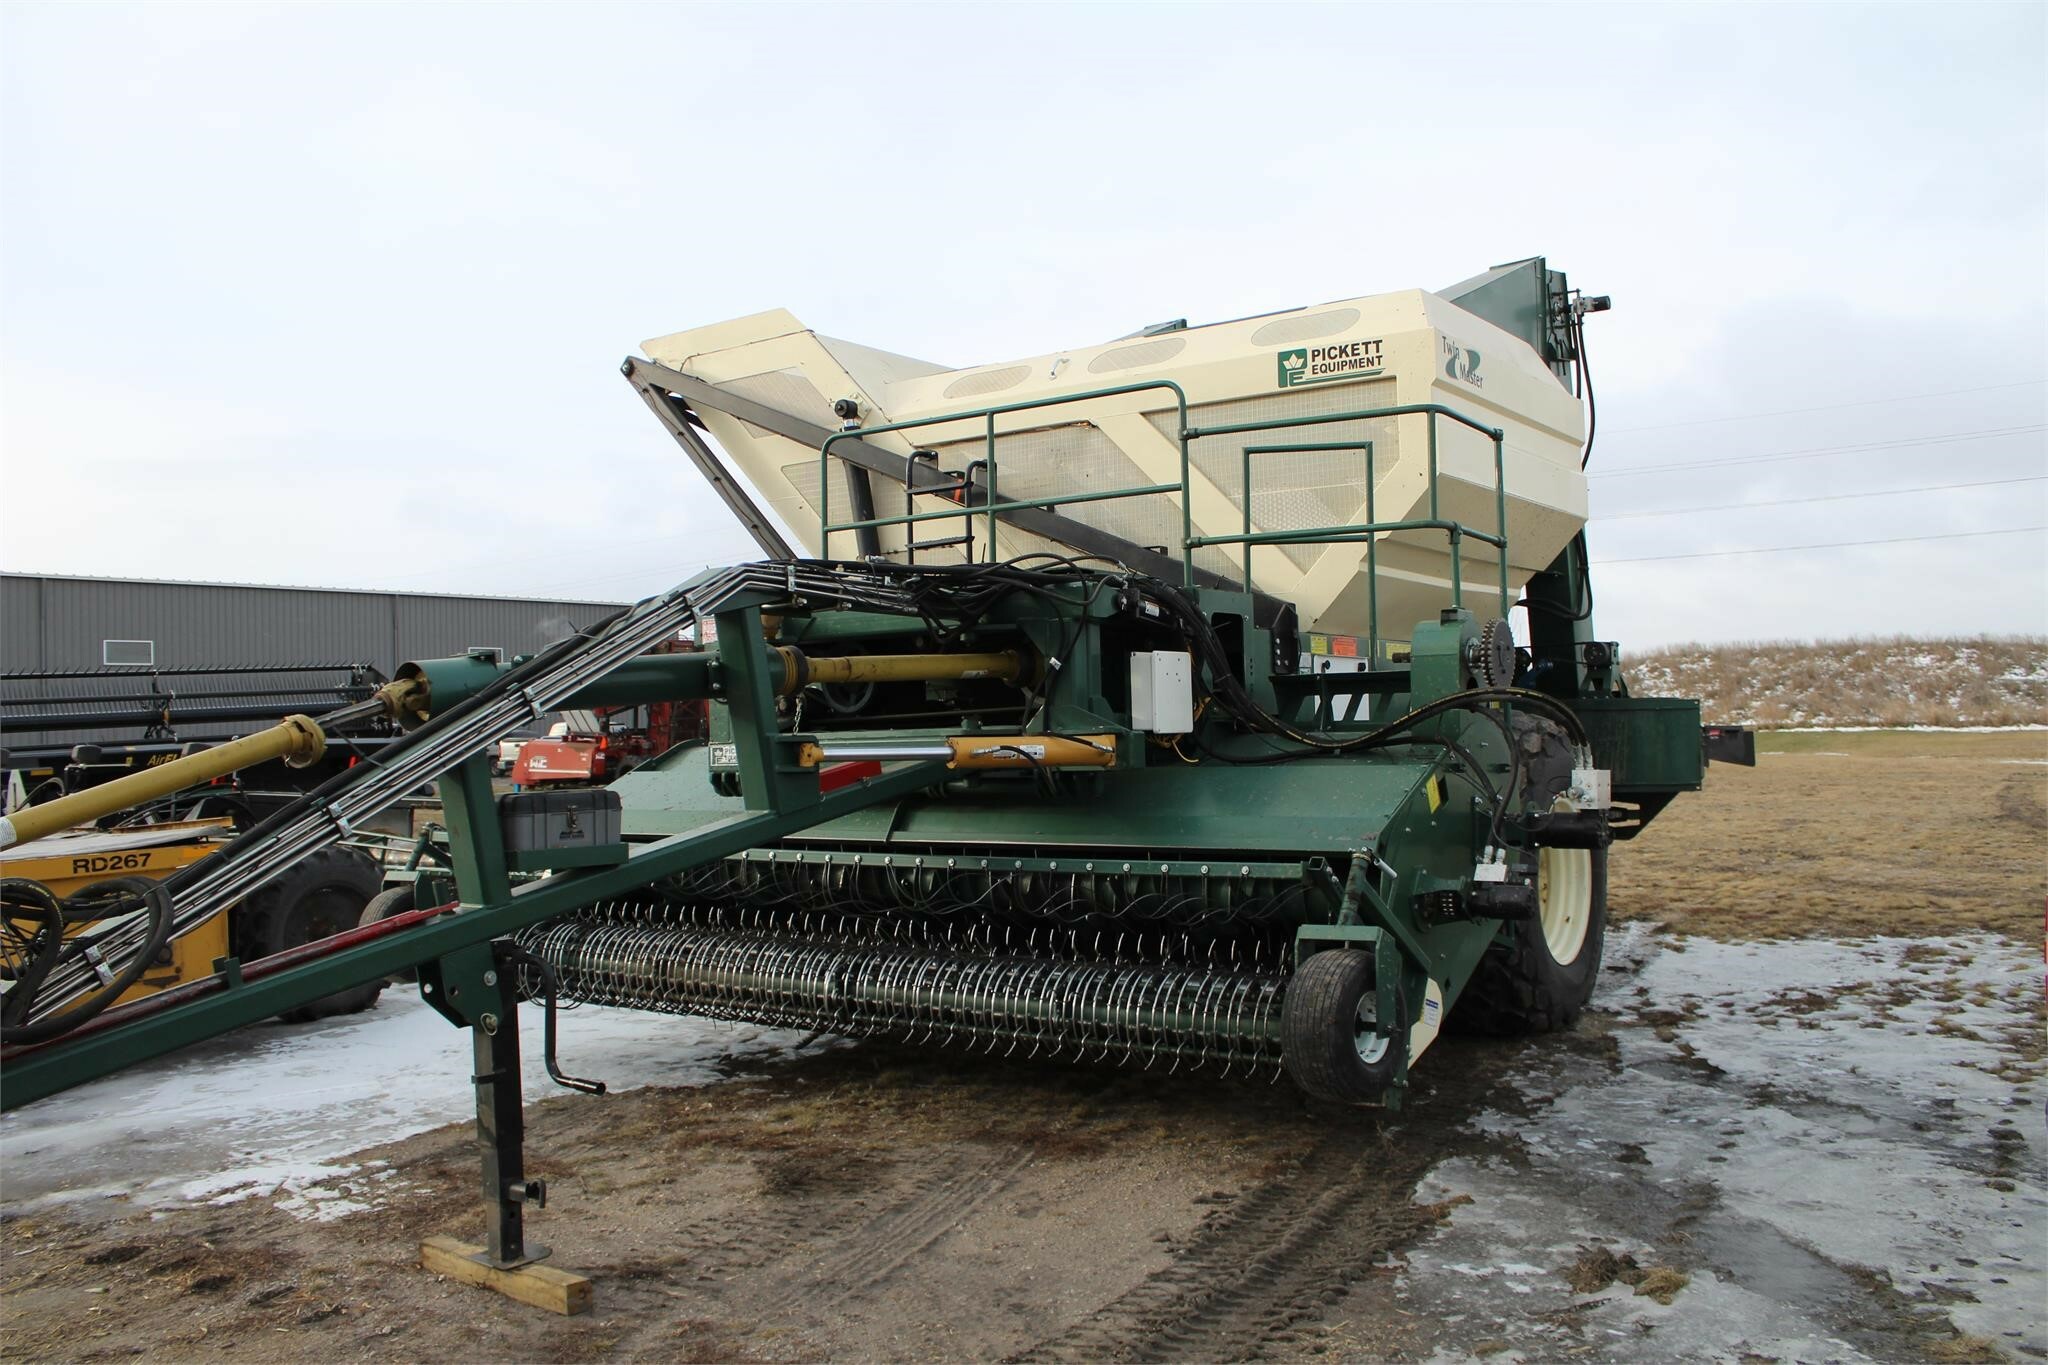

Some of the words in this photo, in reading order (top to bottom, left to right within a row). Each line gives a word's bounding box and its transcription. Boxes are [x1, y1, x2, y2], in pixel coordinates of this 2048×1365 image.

[1311, 339, 1383, 363] PICKETT
[1441, 335, 1460, 361] Twin
[1311, 355, 1383, 375] EQUIPMENT
[1459, 361, 1483, 389] Master
[72, 853, 152, 874] RD267
